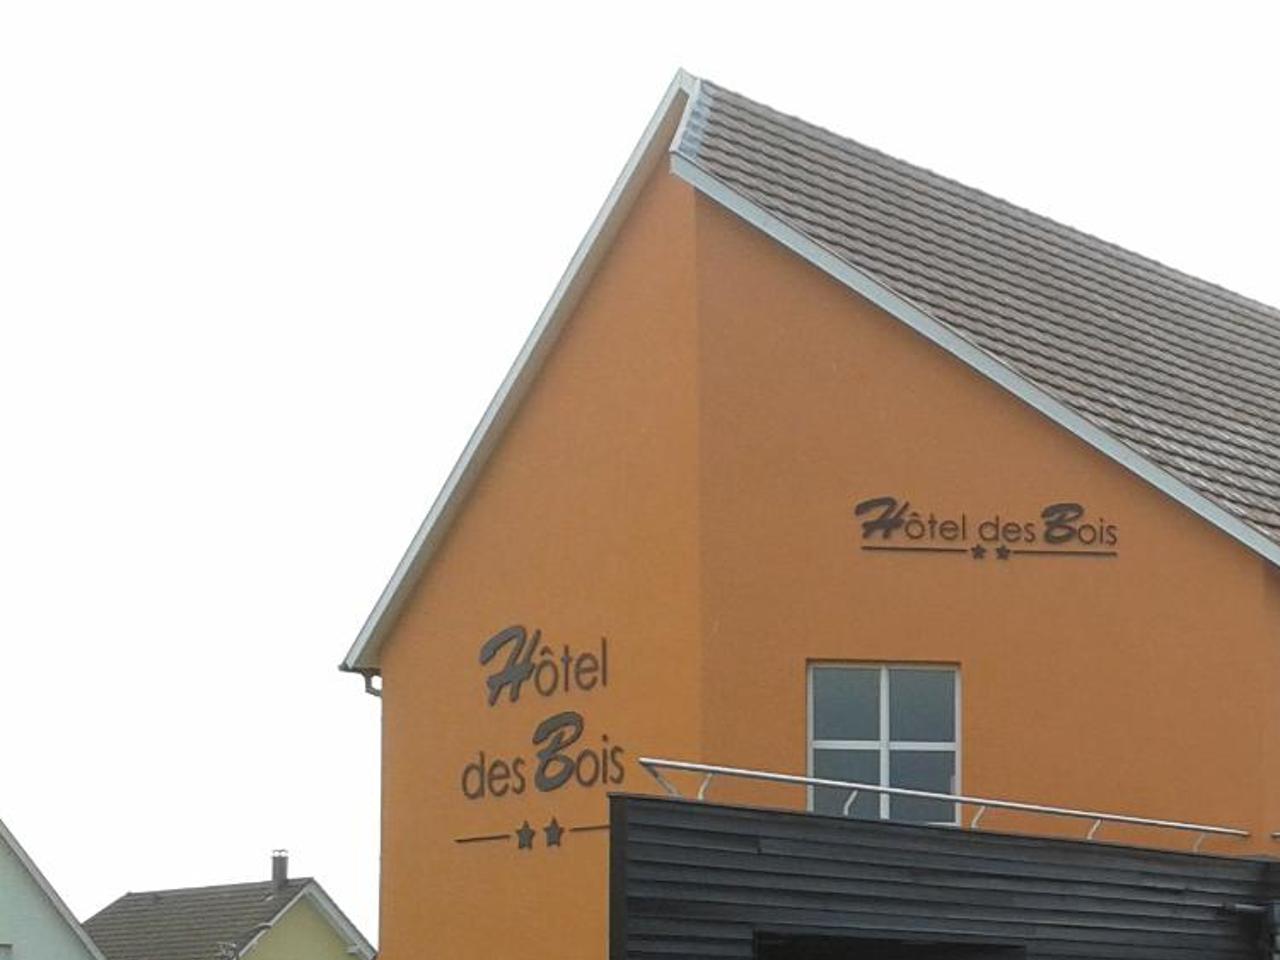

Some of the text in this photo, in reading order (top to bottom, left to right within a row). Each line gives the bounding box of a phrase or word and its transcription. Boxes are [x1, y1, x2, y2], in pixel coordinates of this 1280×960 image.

[854, 497, 1118, 545] Hôtel des Bois
[479, 625, 607, 707] Hôtel
[462, 711, 625, 800] des Bois
